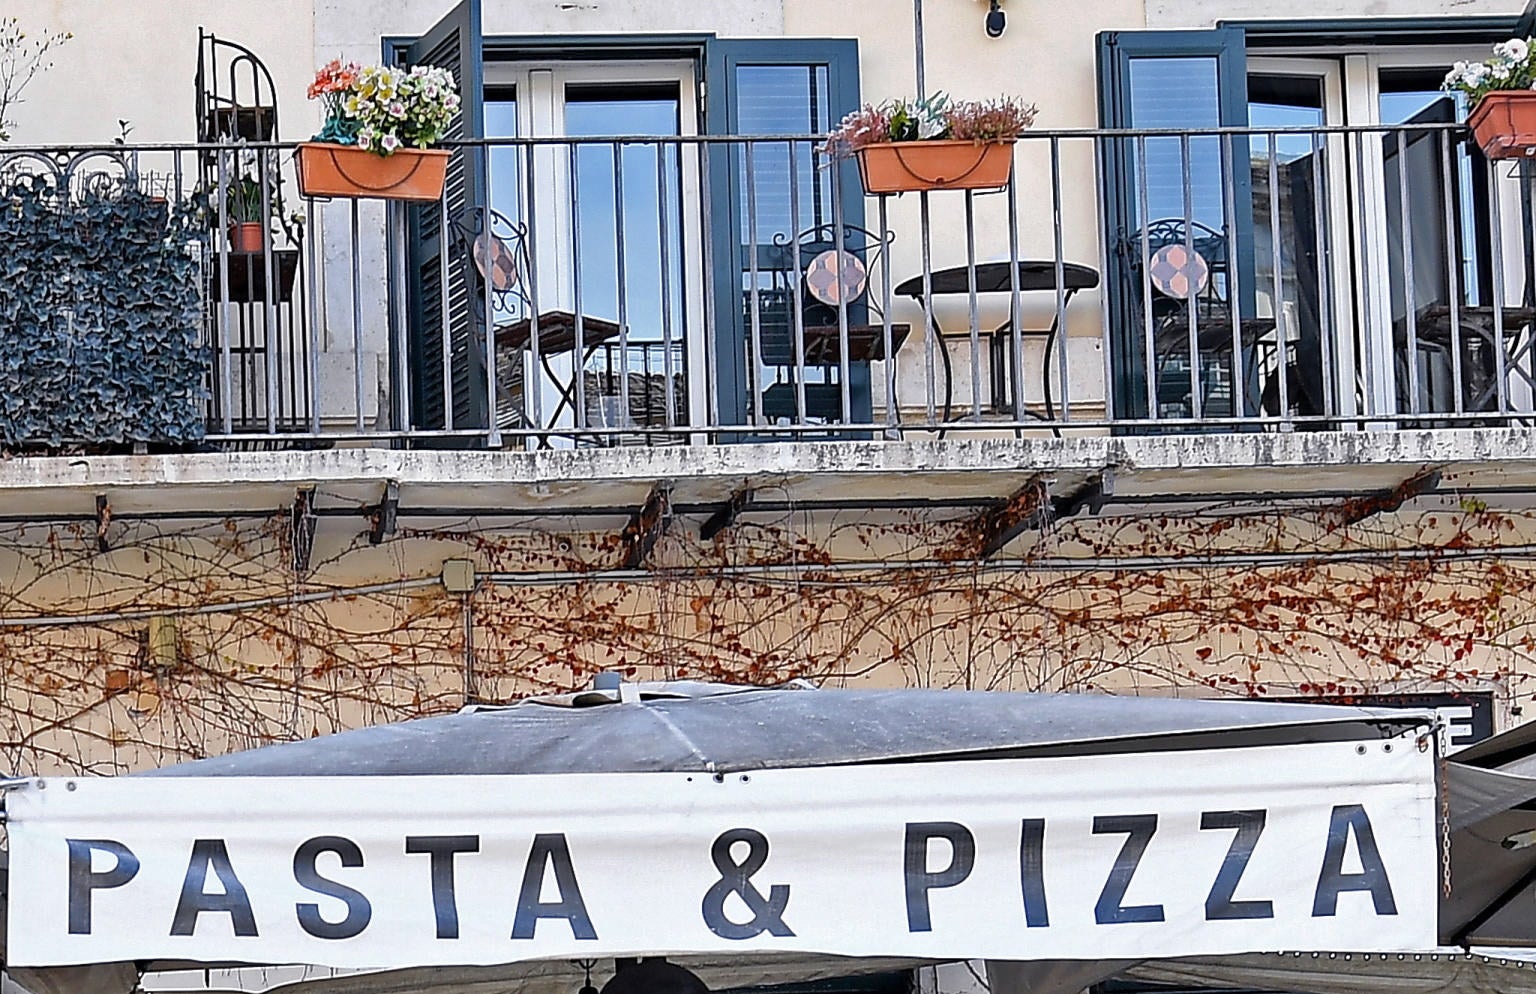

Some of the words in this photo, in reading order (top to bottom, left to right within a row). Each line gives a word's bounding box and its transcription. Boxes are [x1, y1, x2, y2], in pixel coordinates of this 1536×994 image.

[66, 832, 598, 941] PASTA
[702, 828, 797, 940] &
[904, 803, 1399, 933] PIZZA
